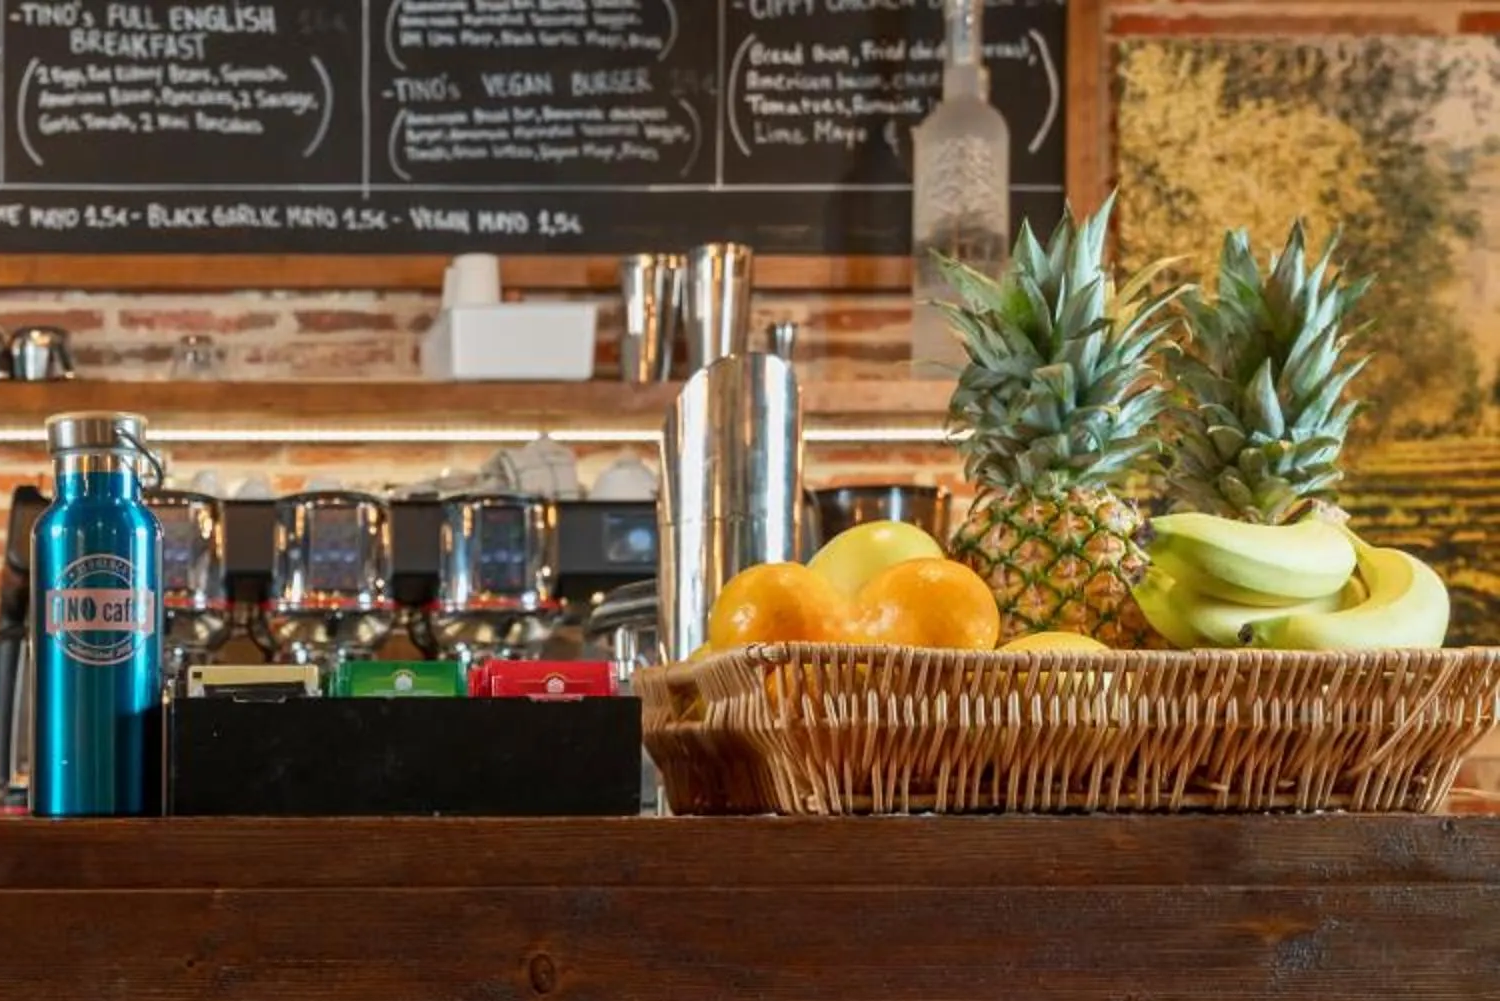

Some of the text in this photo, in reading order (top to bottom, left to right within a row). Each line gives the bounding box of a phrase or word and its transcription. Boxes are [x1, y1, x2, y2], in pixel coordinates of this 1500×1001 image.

[106, 2, 161, 32] FULL
[168, 0, 277, 35] ENGLISH
[68, 27, 208, 60] BREAKFAST
[749, 42, 804, 66] Bread
[479, 71, 554, 98] VEGAN
[569, 67, 655, 98] BURGER
[147, 202, 210, 229] BLACK
[211, 202, 282, 229] GARLIC
